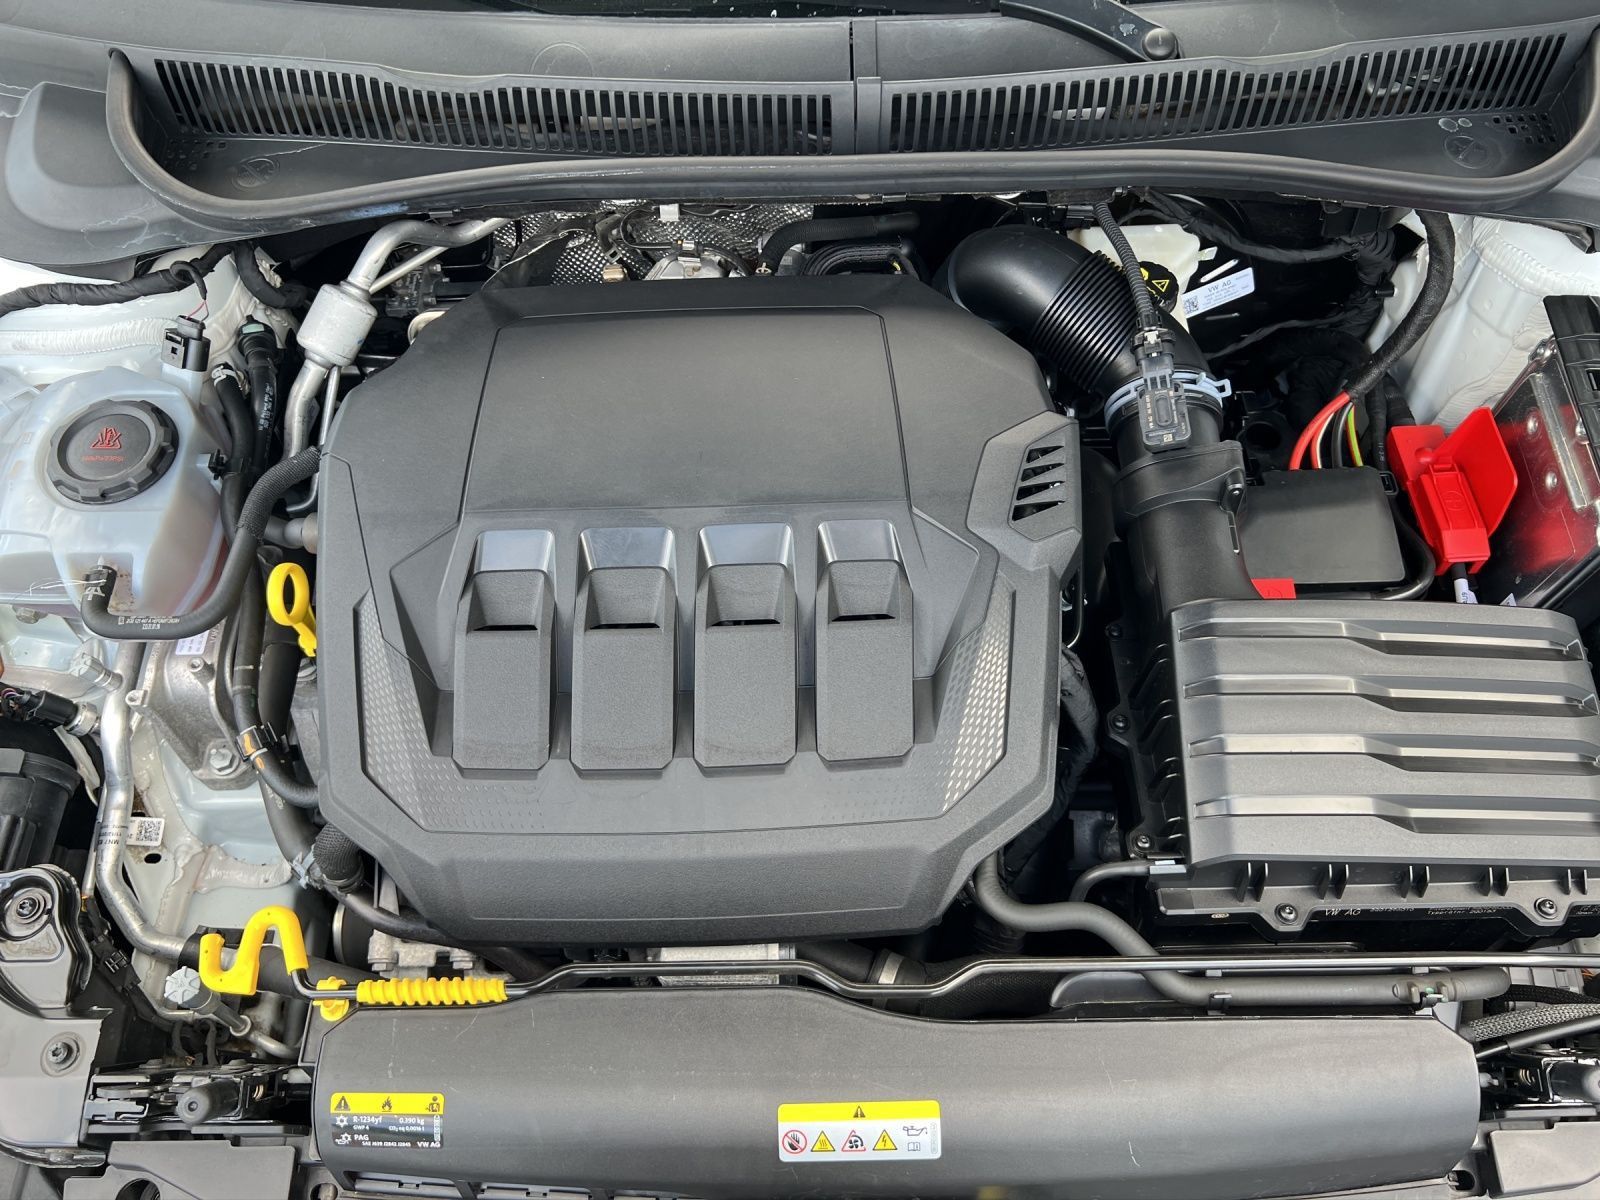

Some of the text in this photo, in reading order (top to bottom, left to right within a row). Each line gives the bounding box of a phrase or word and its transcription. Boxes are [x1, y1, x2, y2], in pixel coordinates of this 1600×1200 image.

[1208, 279, 1232, 293] VW AG
[1325, 908, 1341, 916] VW
[1344, 908, 1361, 916] AG
[353, 1116, 383, 1125] R-1234yf
[417, 1117, 425, 1126] kg
